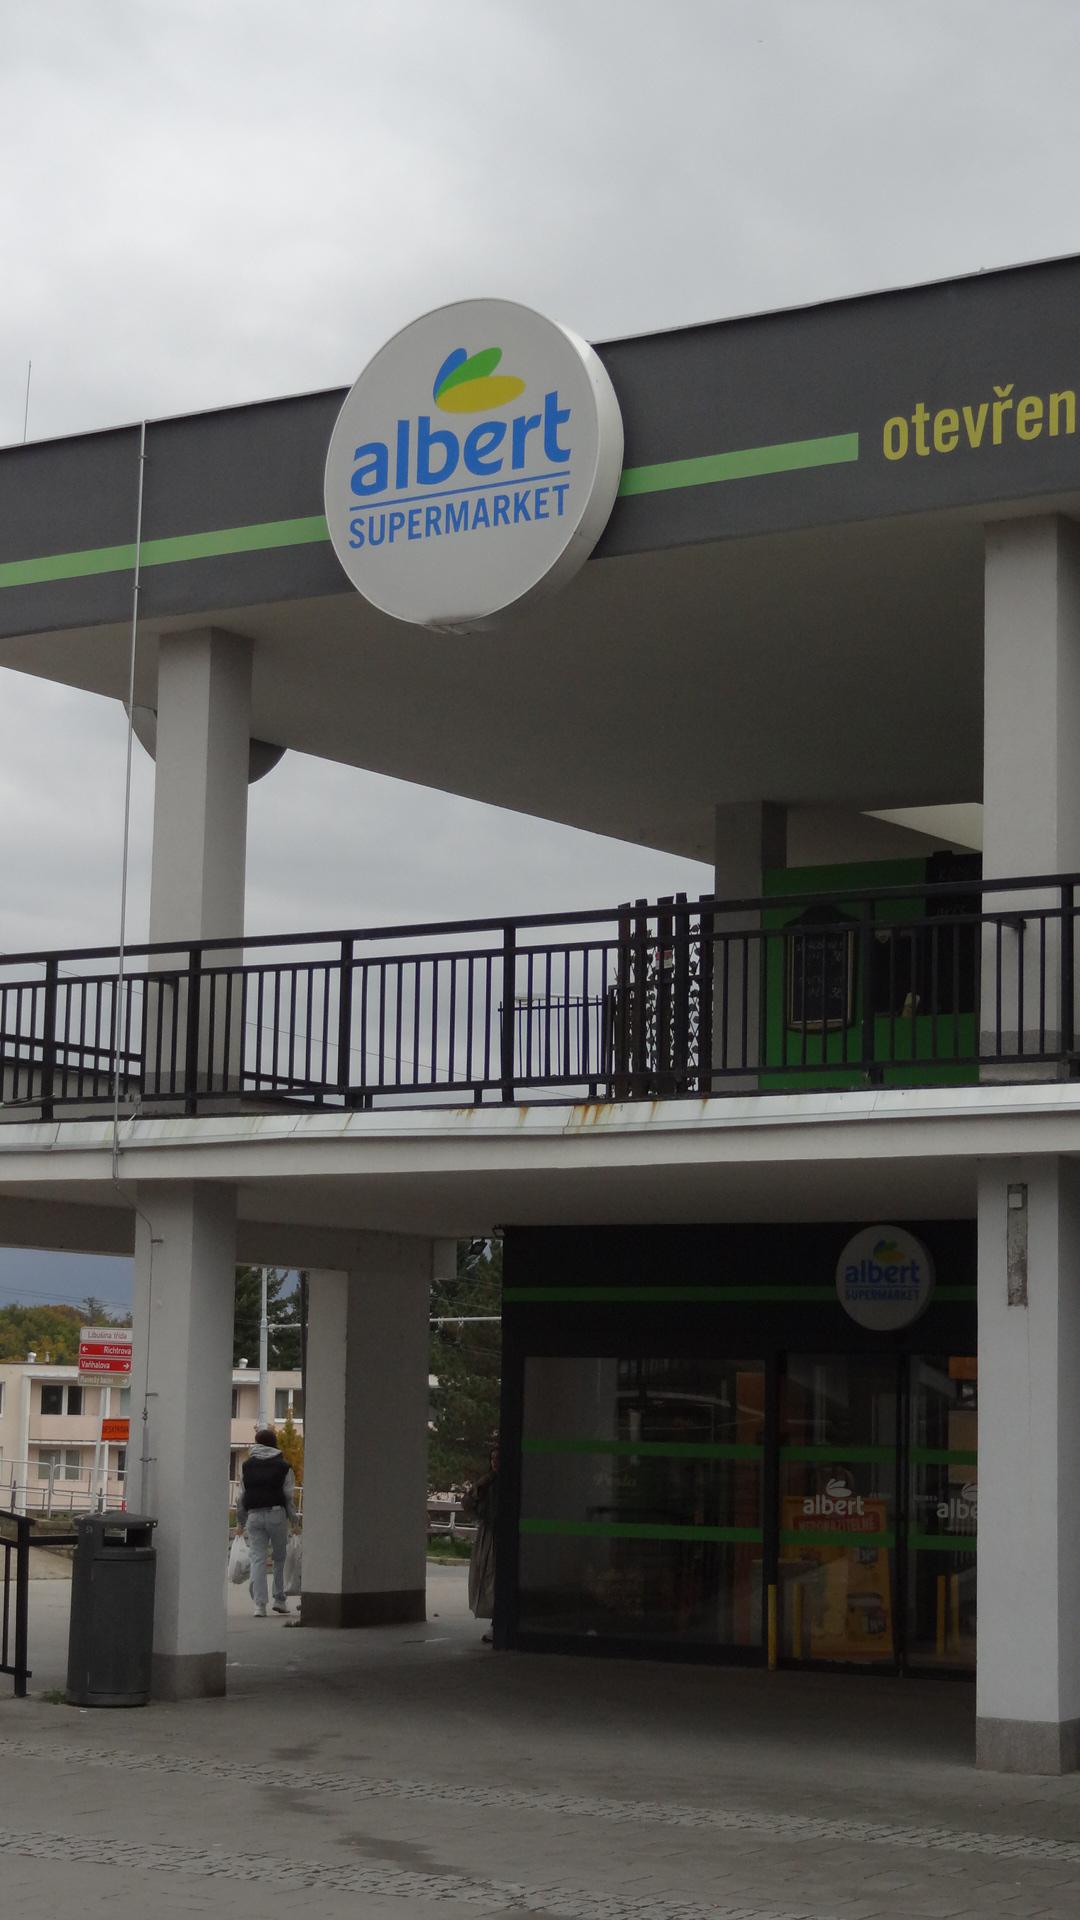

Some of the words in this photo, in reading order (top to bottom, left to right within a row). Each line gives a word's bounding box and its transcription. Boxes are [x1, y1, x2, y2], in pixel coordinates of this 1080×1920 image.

[883, 384, 1076, 461] otevřen
[350, 391, 571, 497] albert
[349, 483, 570, 549] SUPERMARKET
[846, 1259, 920, 1283] albert
[846, 1288, 920, 1301] SUPERMARKET
[103, 1345, 132, 1355] Richtrova
[803, 1494, 865, 1516] albert
